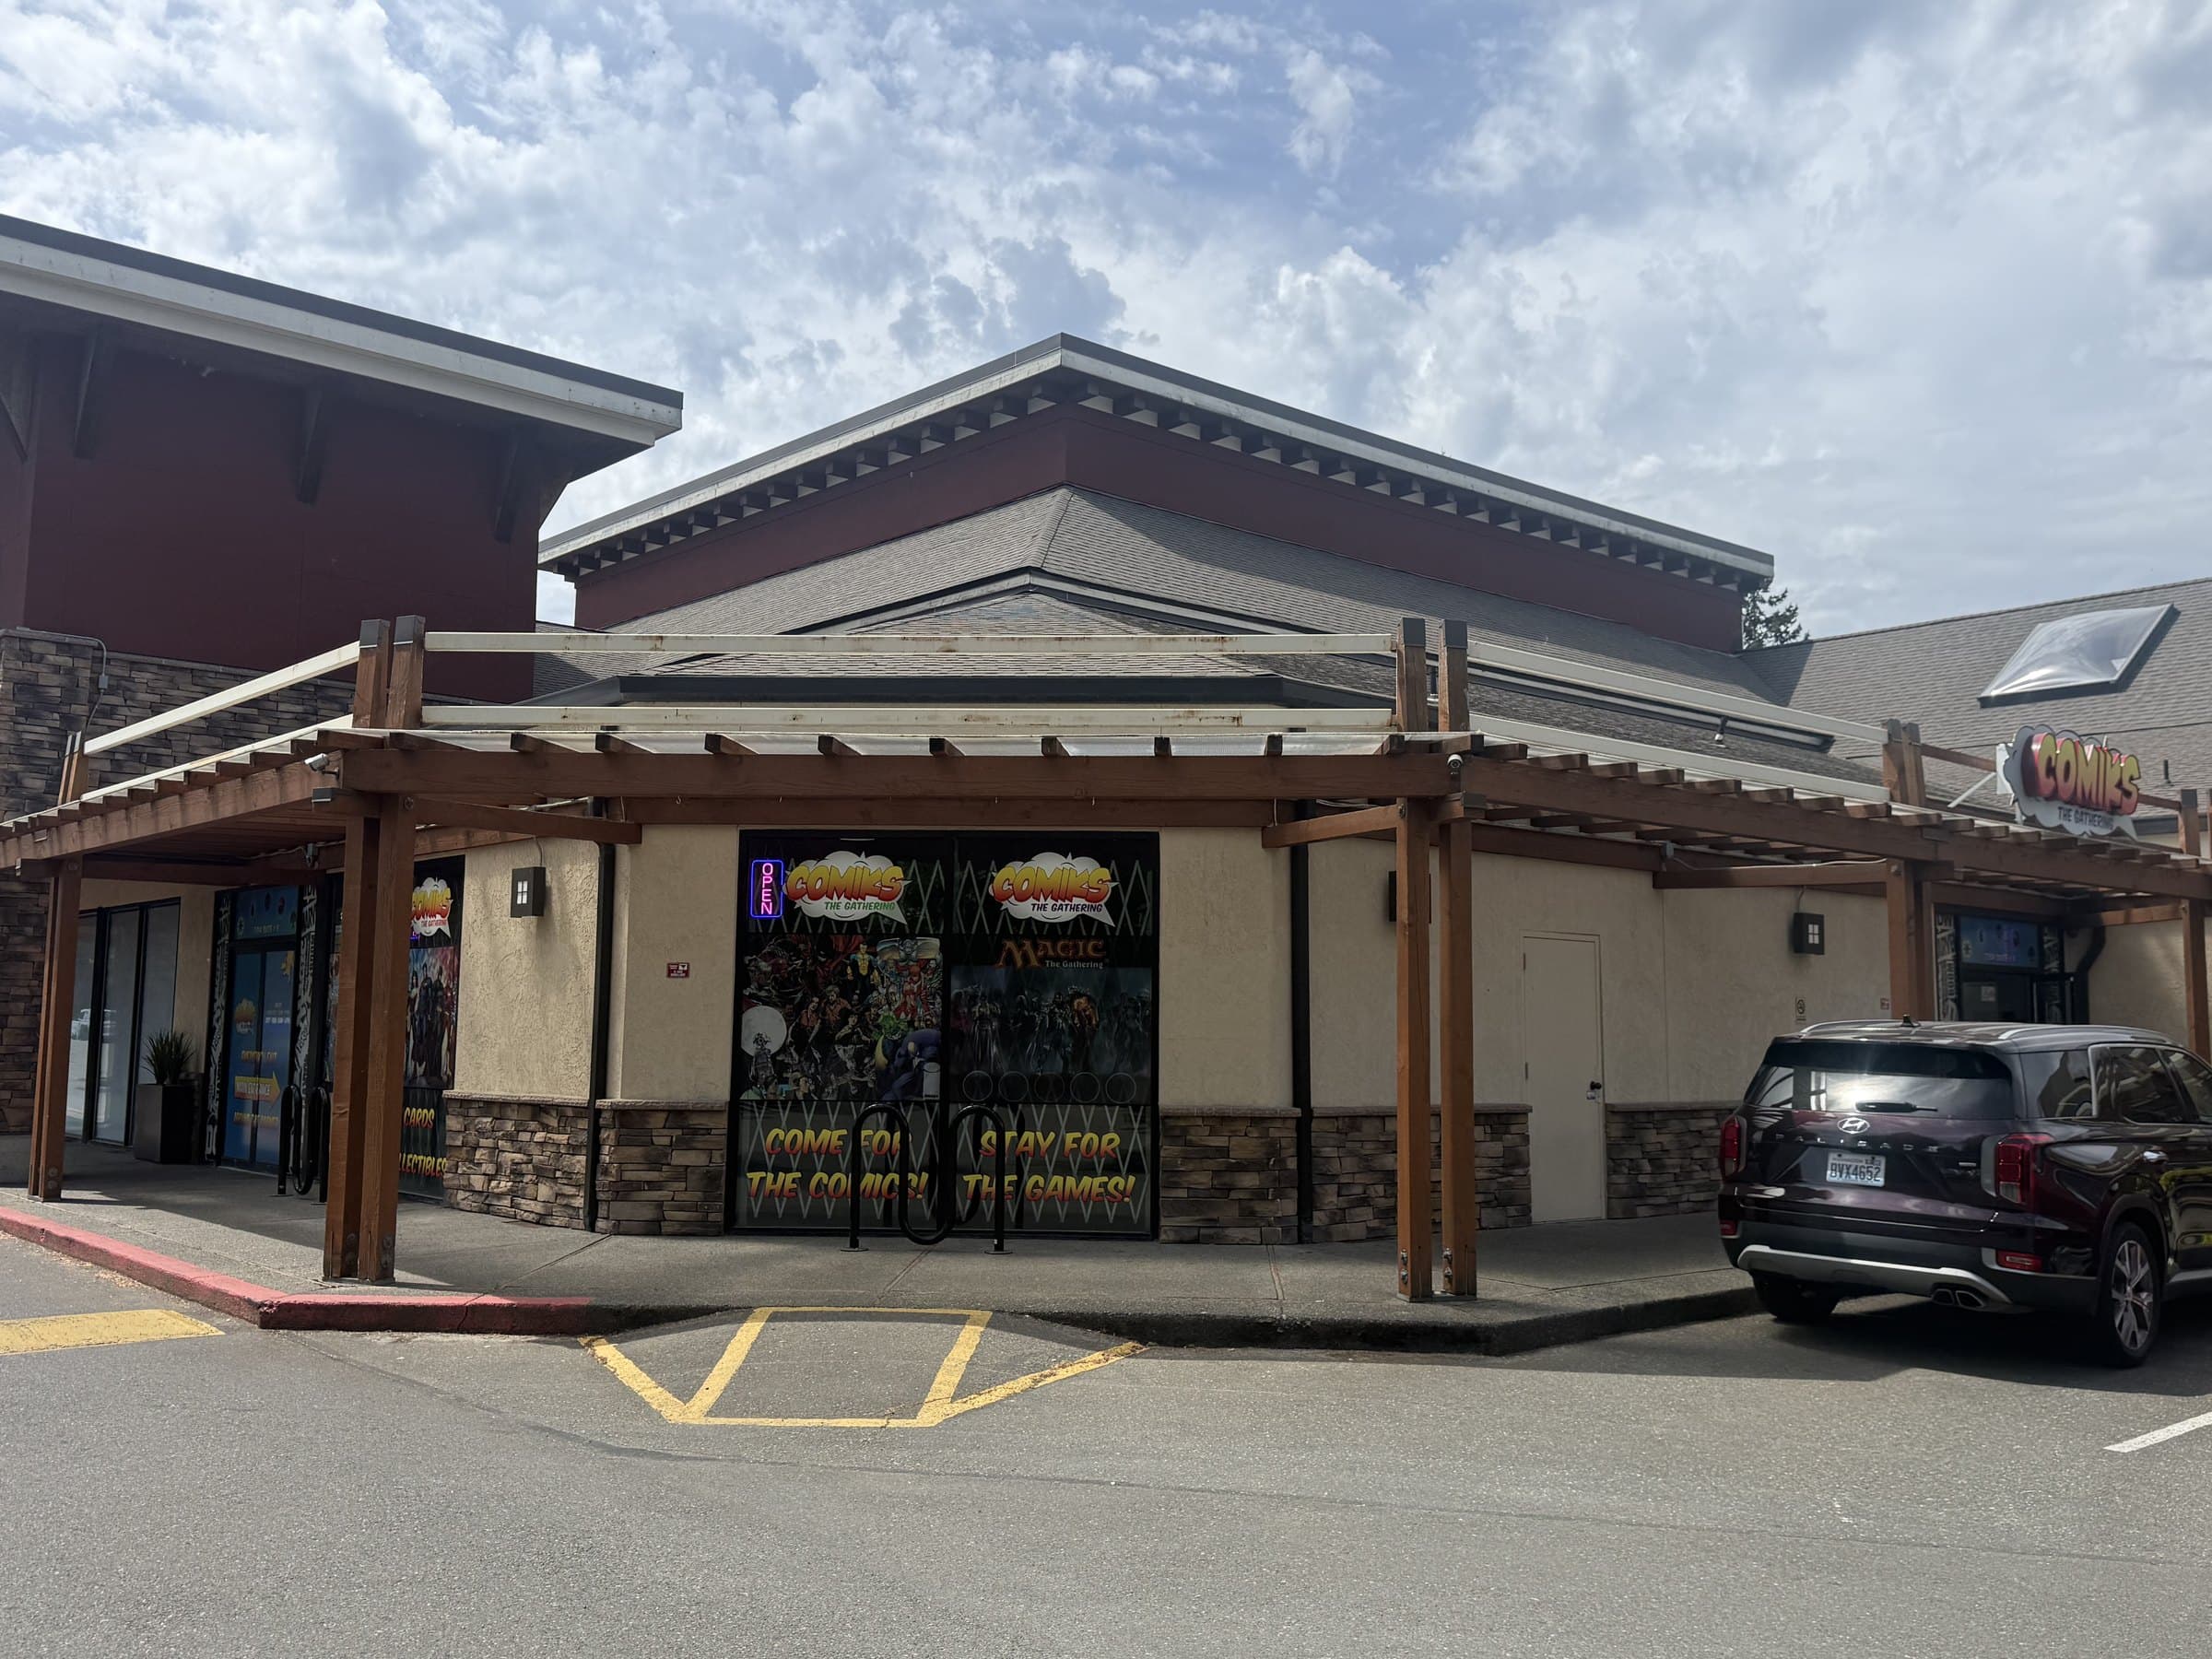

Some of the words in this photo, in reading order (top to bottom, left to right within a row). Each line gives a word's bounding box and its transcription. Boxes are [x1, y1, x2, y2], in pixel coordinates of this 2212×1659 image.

[2030, 733, 2141, 816] COMIKS
[2057, 806, 2072, 822] THE
[2073, 808, 2114, 829] GATHERING
[760, 862, 774, 915] OPEN
[785, 865, 905, 902] COMIKS
[992, 866, 1112, 903] COMIKS
[825, 901, 841, 911] THE
[844, 901, 896, 912] GATHERING
[1031, 903, 1048, 912] THE
[1051, 903, 1103, 912] GATHERING
[994, 937, 1107, 971] MAGIC
[1045, 959, 1061, 969] The
[1062, 959, 1104, 970] Gathering
[403, 1106, 435, 1129] CARDS
[765, 1127, 848, 1156] COME
[979, 1130, 1057, 1159] STAY
[1063, 1131, 1122, 1159] FOR
[746, 1171, 803, 1199] THE
[962, 1173, 1018, 1201] THE
[1025, 1173, 1136, 1204] GAMES!
